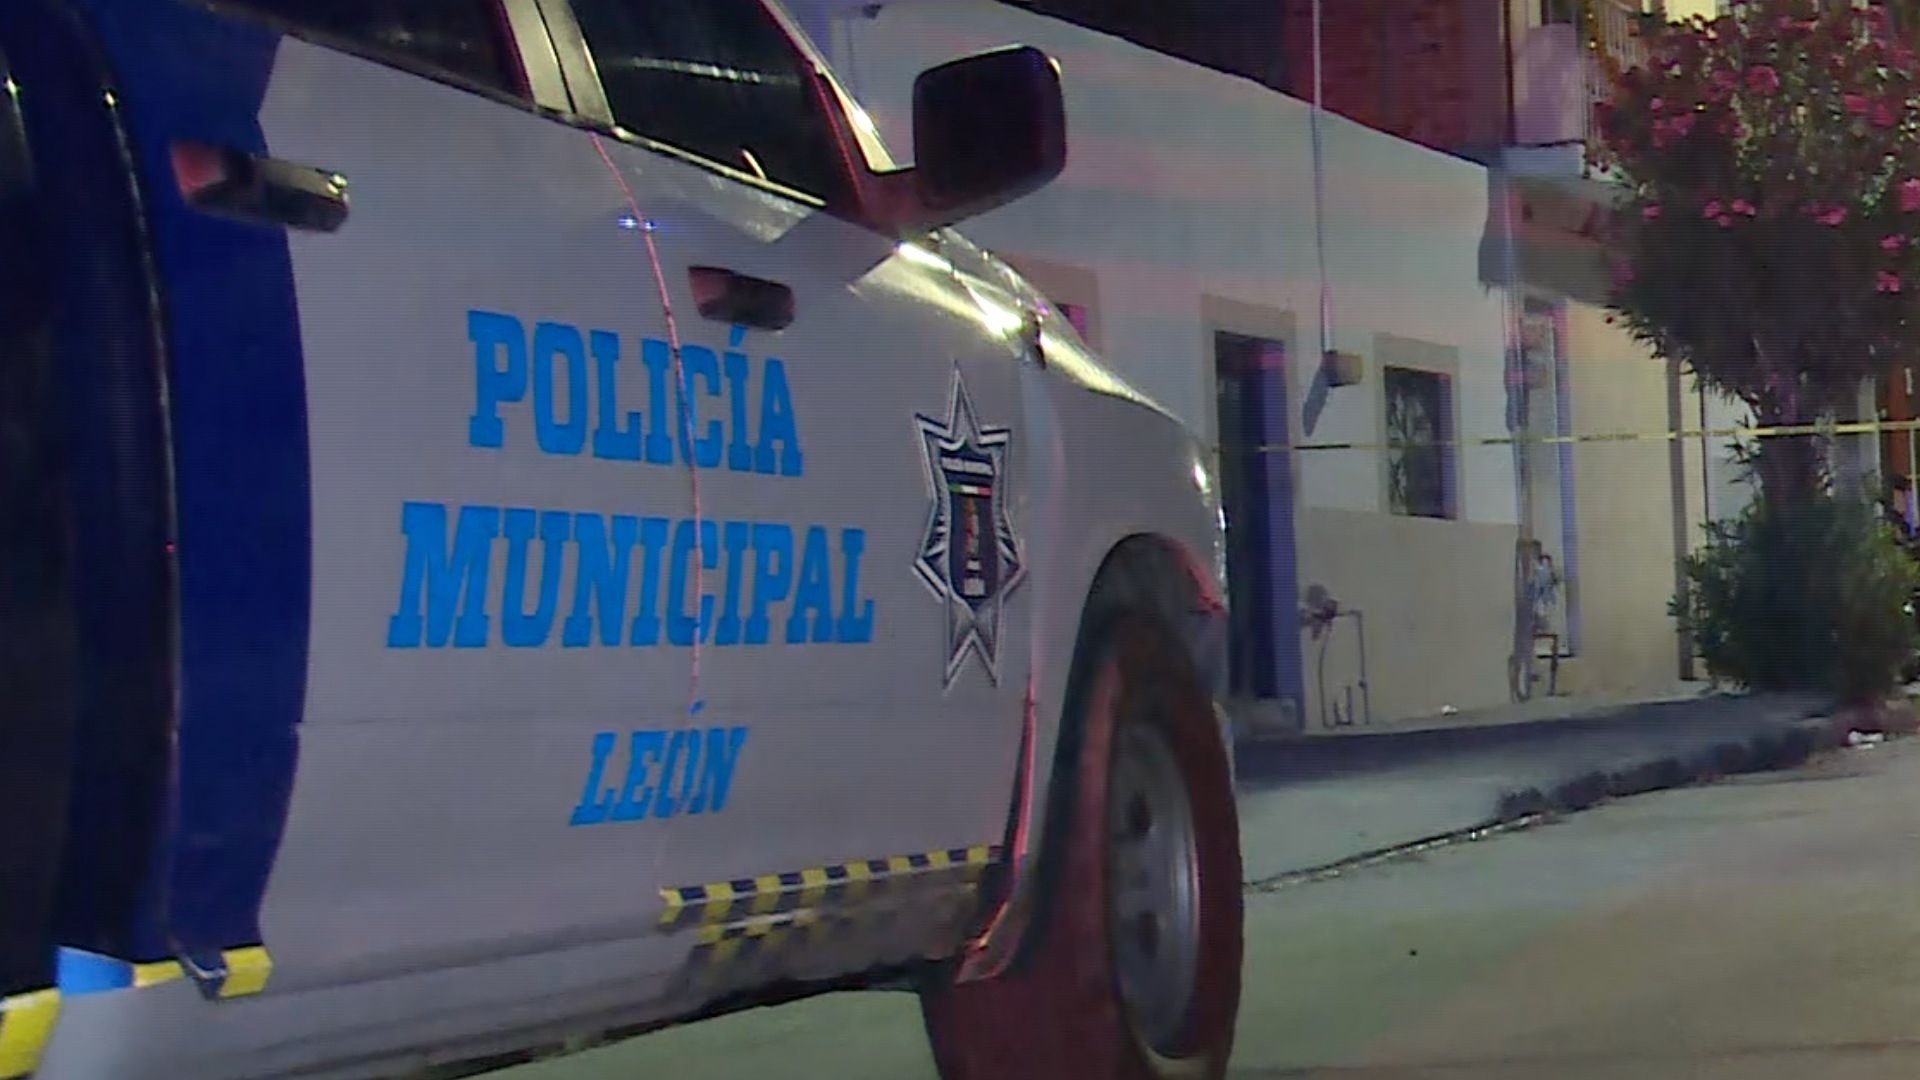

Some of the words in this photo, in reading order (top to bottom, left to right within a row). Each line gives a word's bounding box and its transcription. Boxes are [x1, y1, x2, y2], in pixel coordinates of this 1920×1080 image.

[467, 310, 803, 477] POLICÍA
[386, 501, 874, 648] MUNICIPAL
[568, 700, 748, 826] LEÓN
